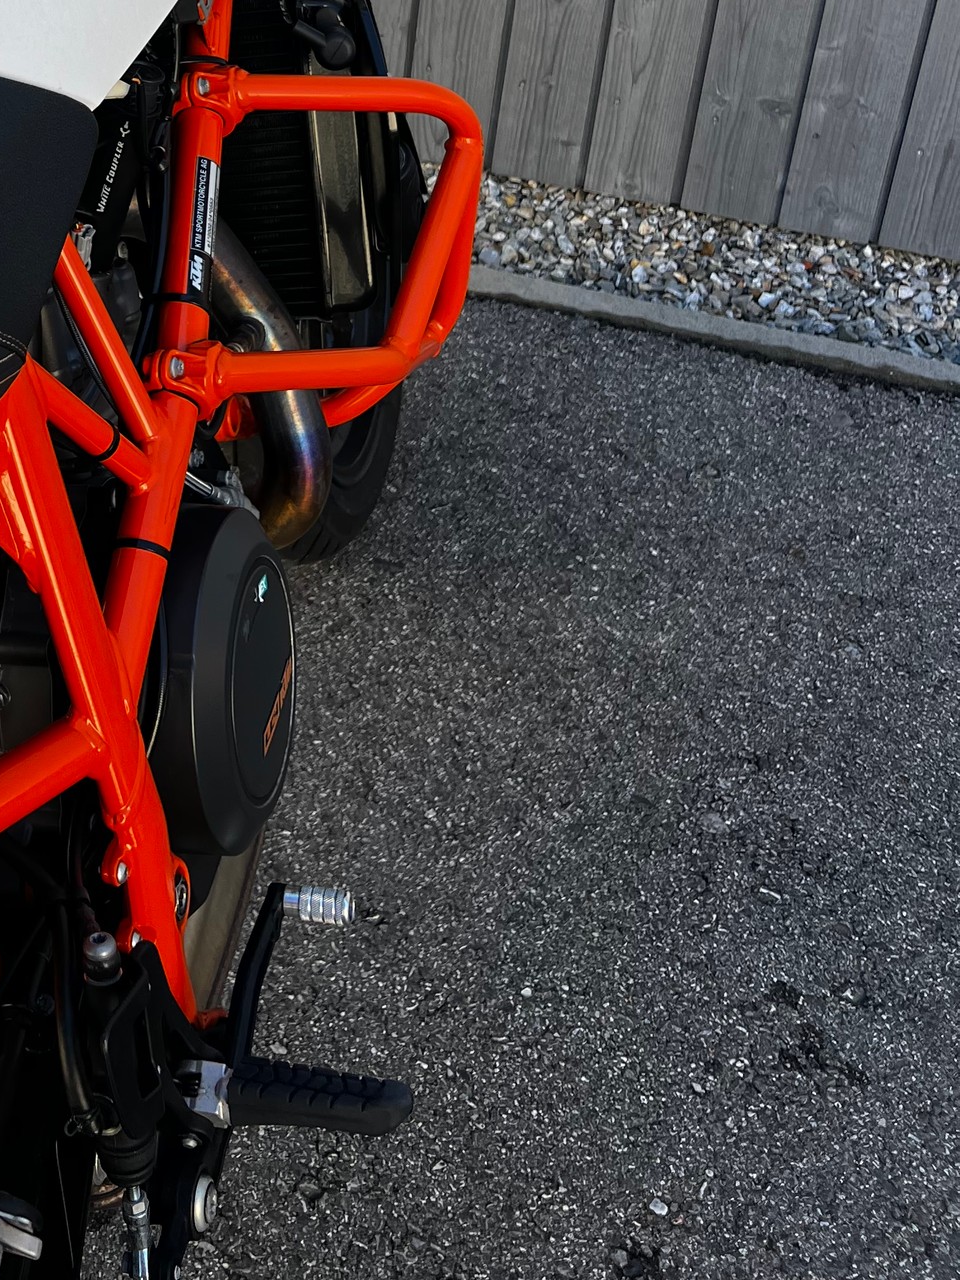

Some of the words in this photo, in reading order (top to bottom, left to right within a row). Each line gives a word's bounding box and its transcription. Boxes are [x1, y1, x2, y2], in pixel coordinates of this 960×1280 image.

[106, 141, 124, 183] COUPLER
[200, 159, 208, 168] AG
[195, 171, 207, 233] SPORTMOTORCYCLE
[190, 254, 204, 291] KTM
